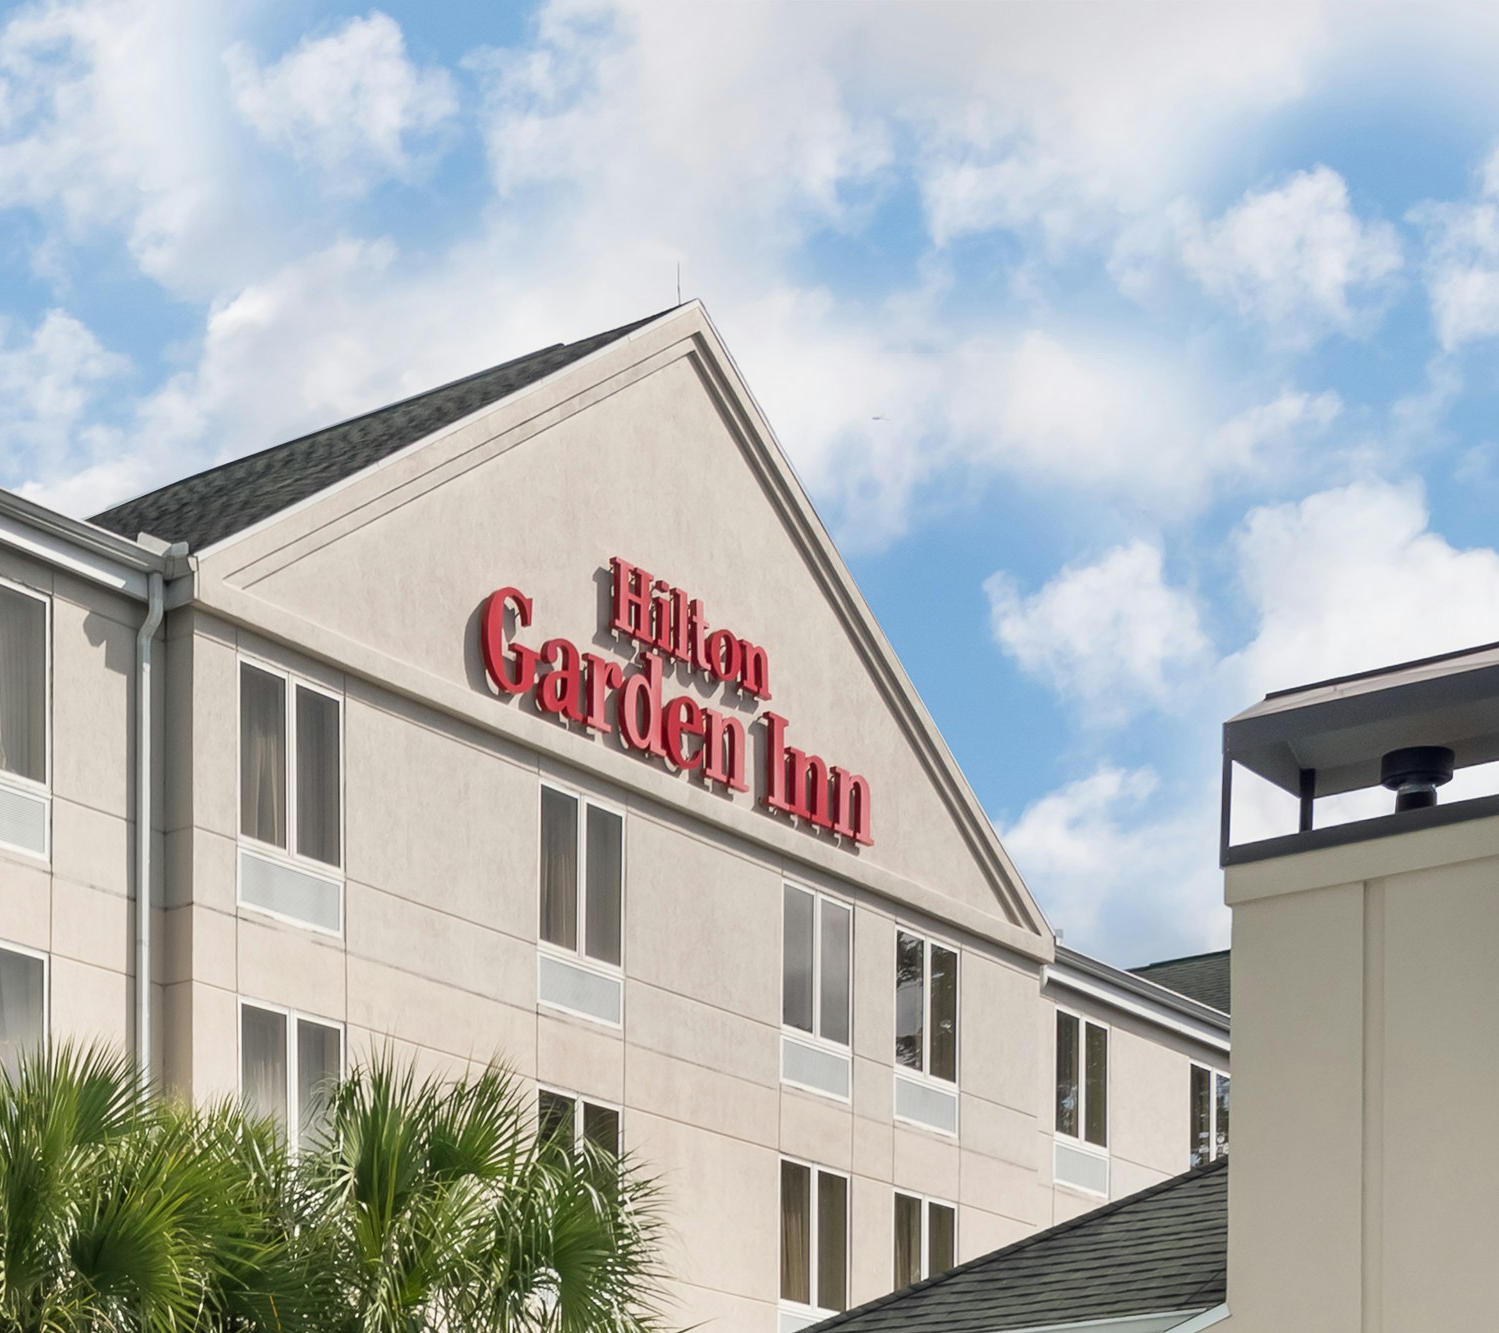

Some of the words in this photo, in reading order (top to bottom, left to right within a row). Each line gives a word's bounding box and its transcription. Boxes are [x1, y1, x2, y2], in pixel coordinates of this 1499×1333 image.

[480, 586, 750, 793] Garden
[761, 710, 875, 847] Inn
[609, 556, 772, 701] Hilton
